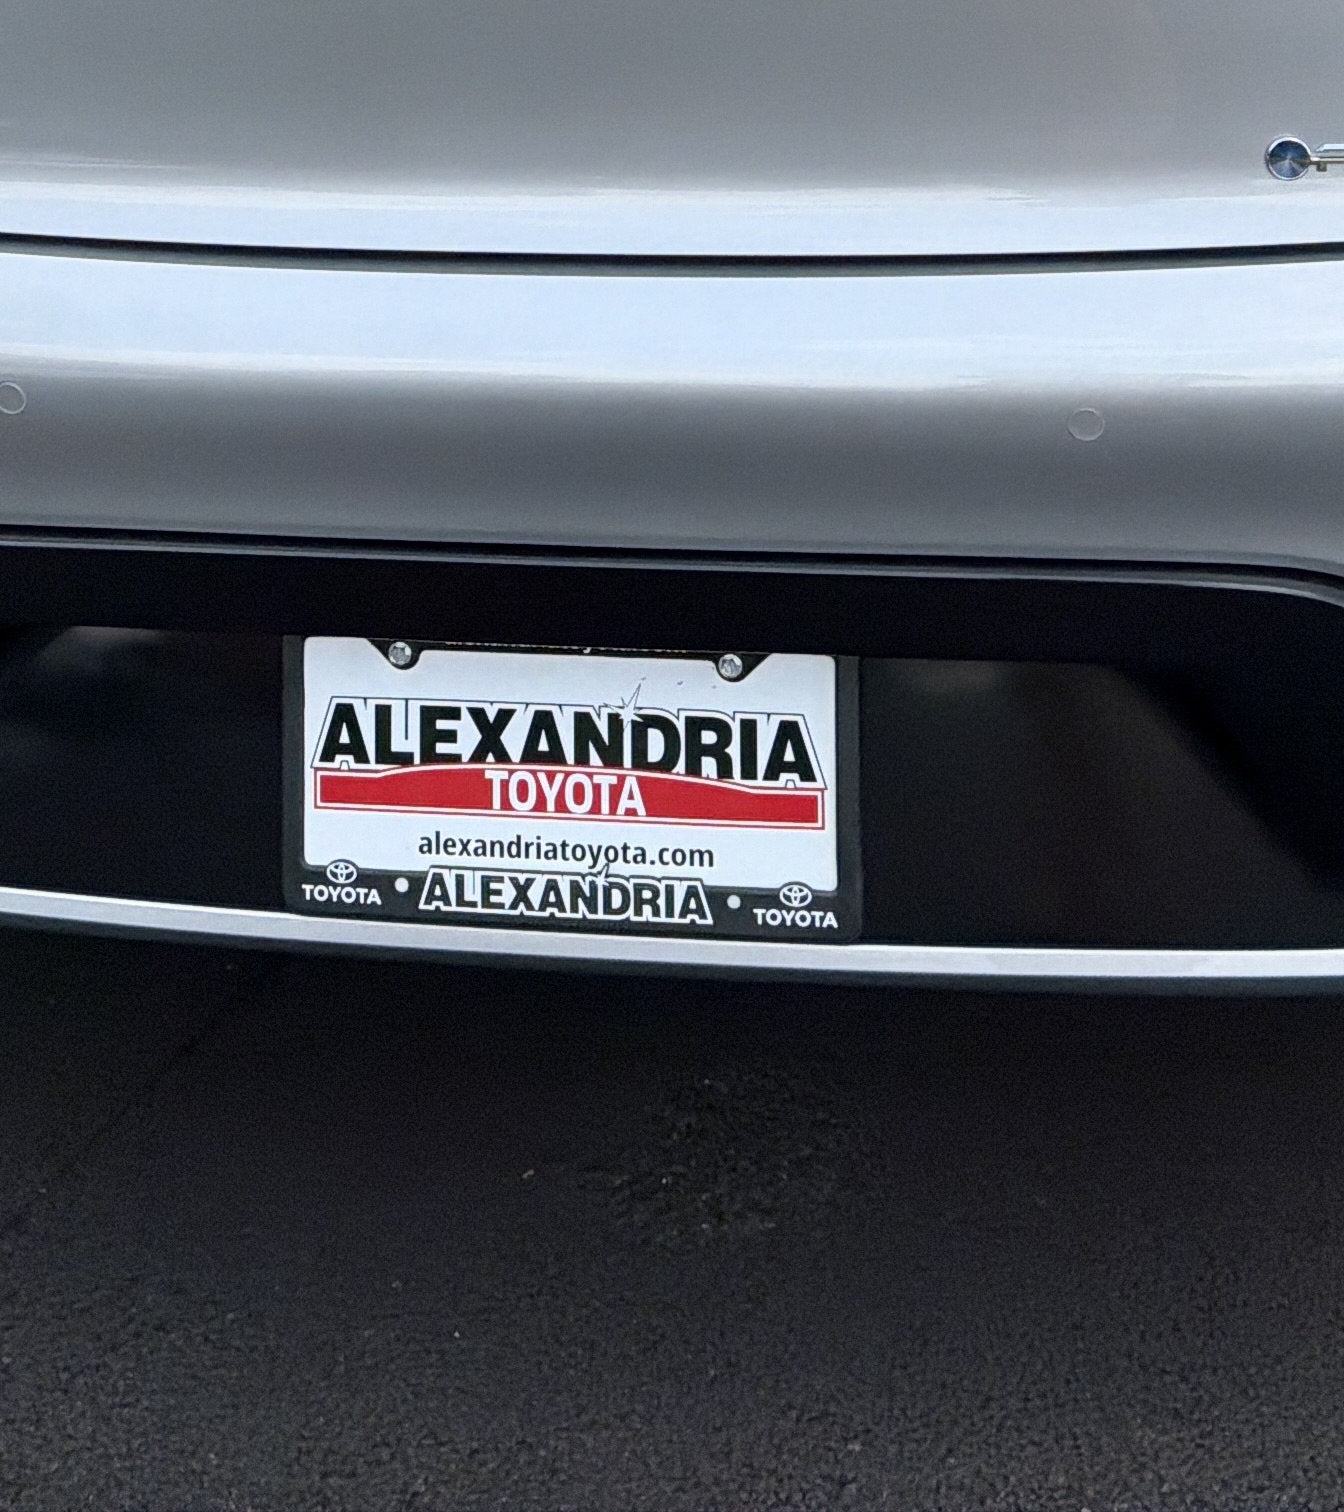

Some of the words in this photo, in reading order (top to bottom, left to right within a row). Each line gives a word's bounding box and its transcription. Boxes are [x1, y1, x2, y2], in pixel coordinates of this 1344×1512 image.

[317, 700, 819, 785] ALEXANDRIA
[485, 769, 646, 817] TOYOTA
[417, 831, 716, 869] alexandriatoyota.com
[302, 883, 382, 907] TOYOTA
[418, 866, 714, 926] ALEXANDRIA
[754, 908, 839, 930] TOYOTA
